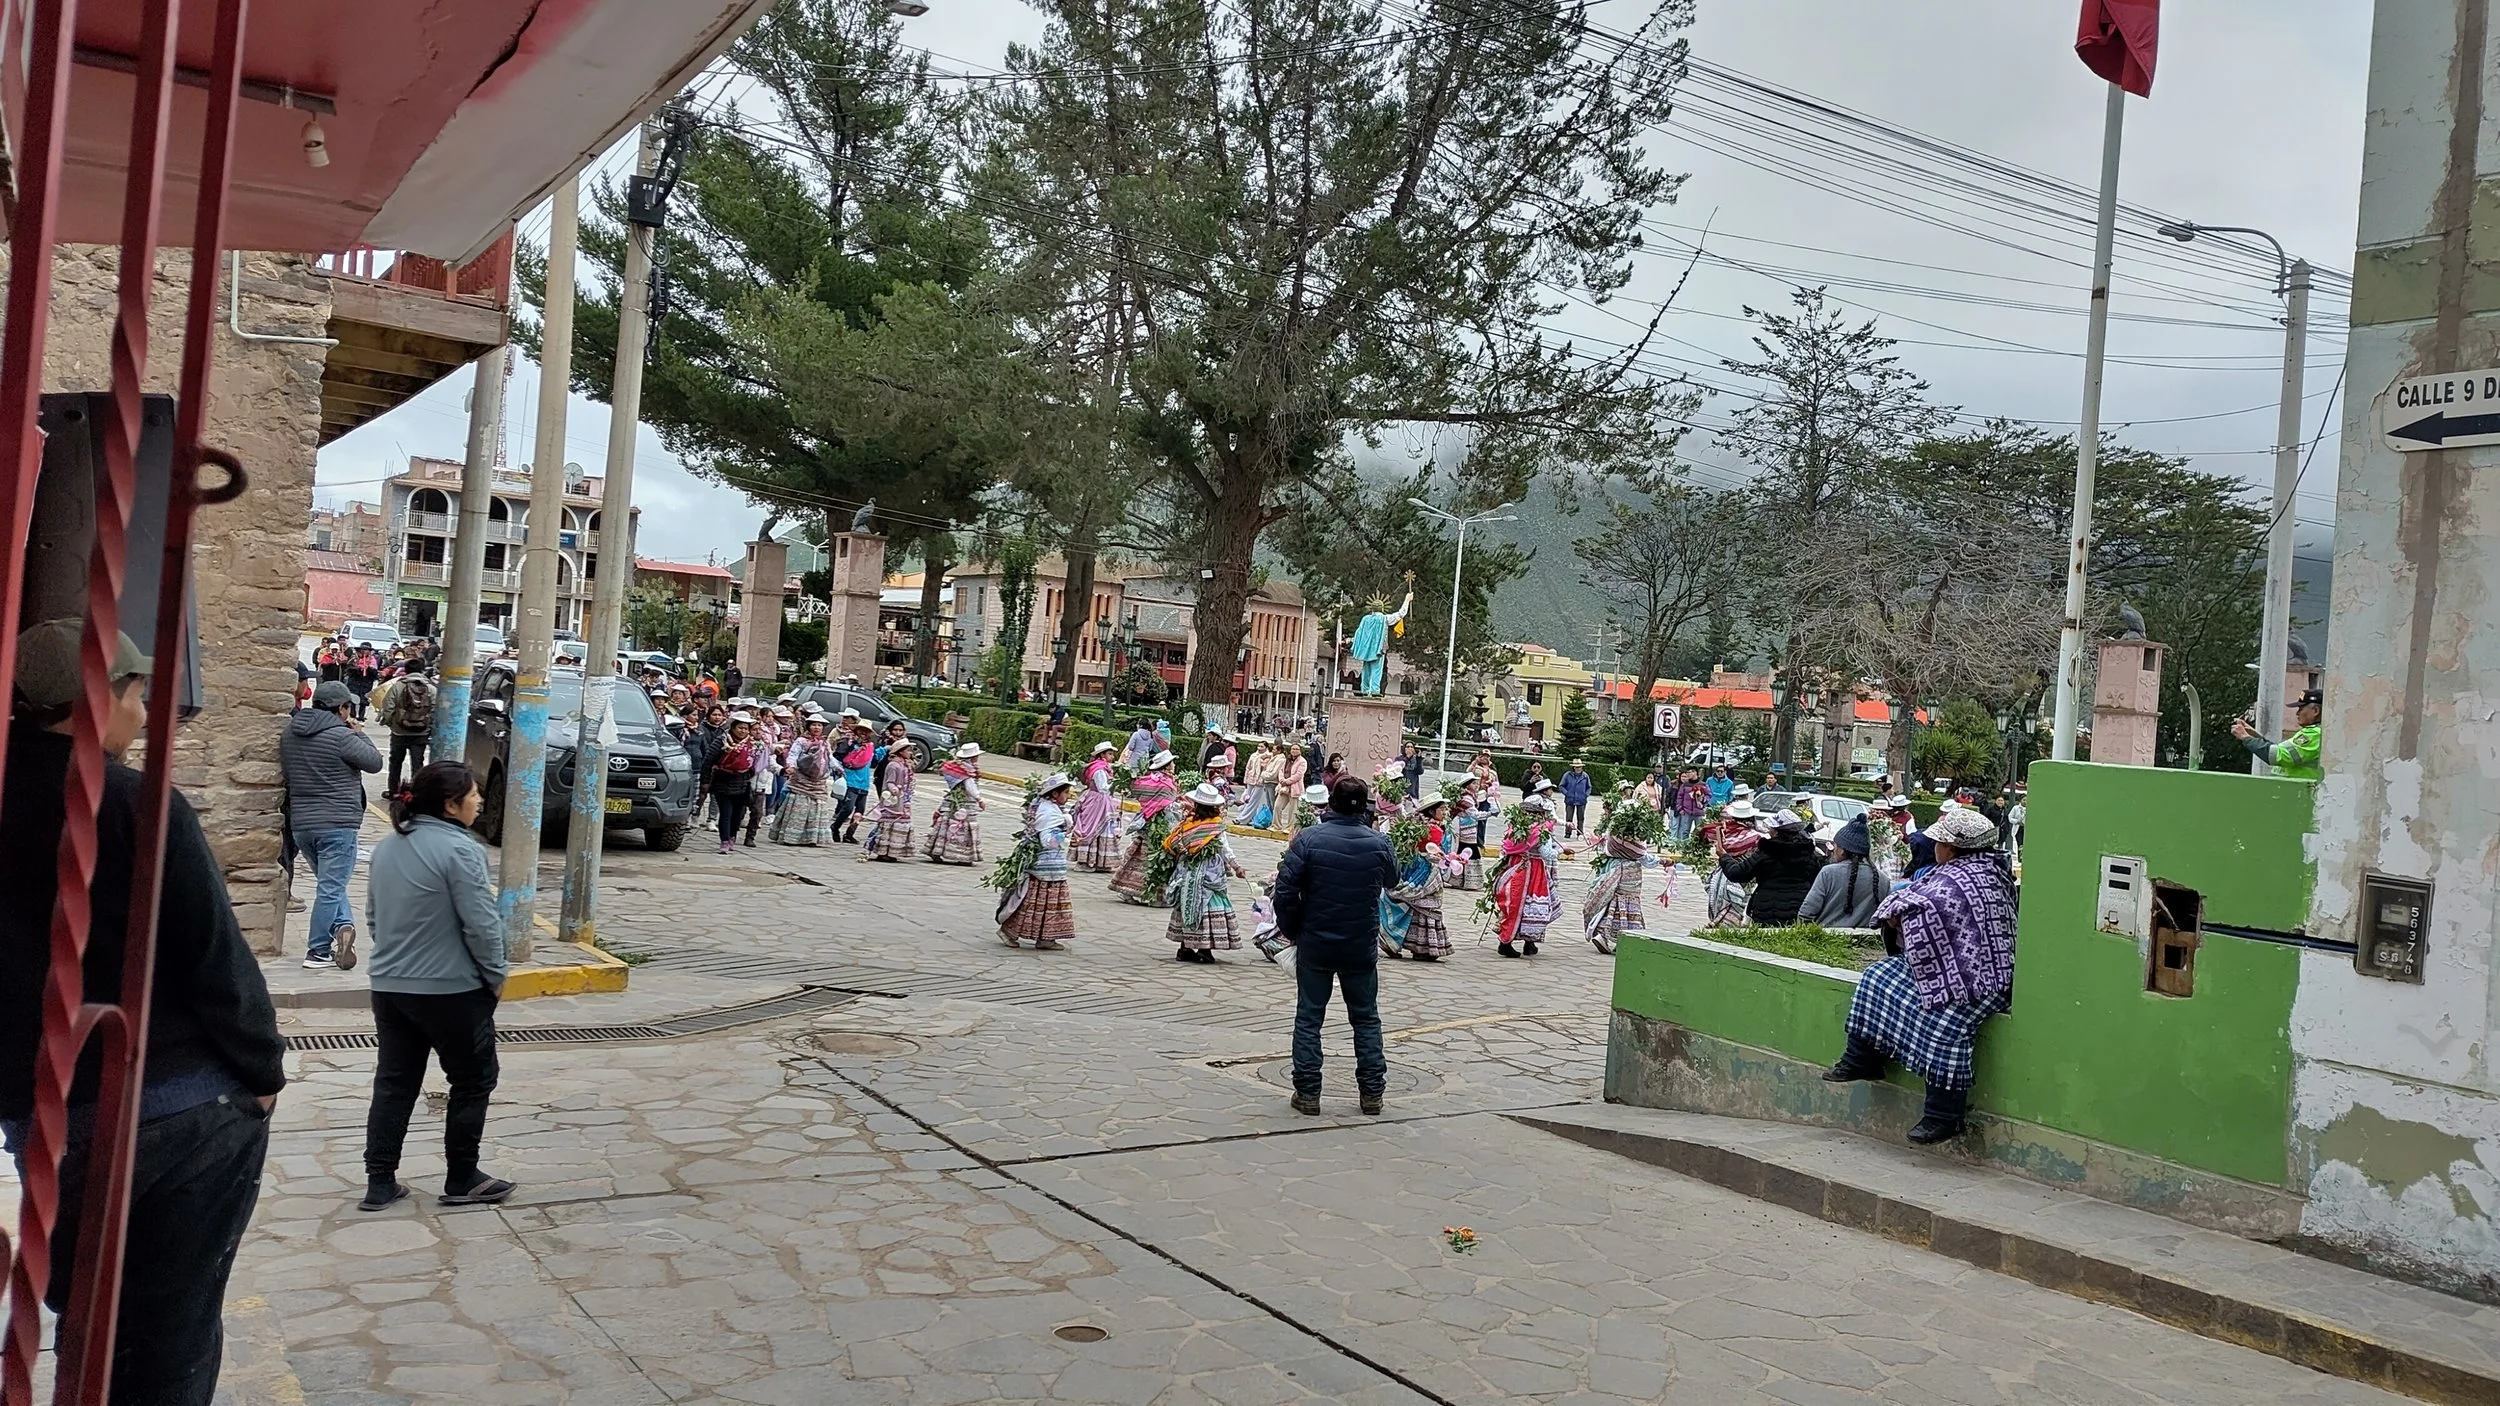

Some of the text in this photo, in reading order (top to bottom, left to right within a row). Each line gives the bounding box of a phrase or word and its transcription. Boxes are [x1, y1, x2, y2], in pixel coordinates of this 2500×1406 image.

[2397, 376, 2500, 408] CALLE 9 D
[1662, 711, 1672, 729] E
